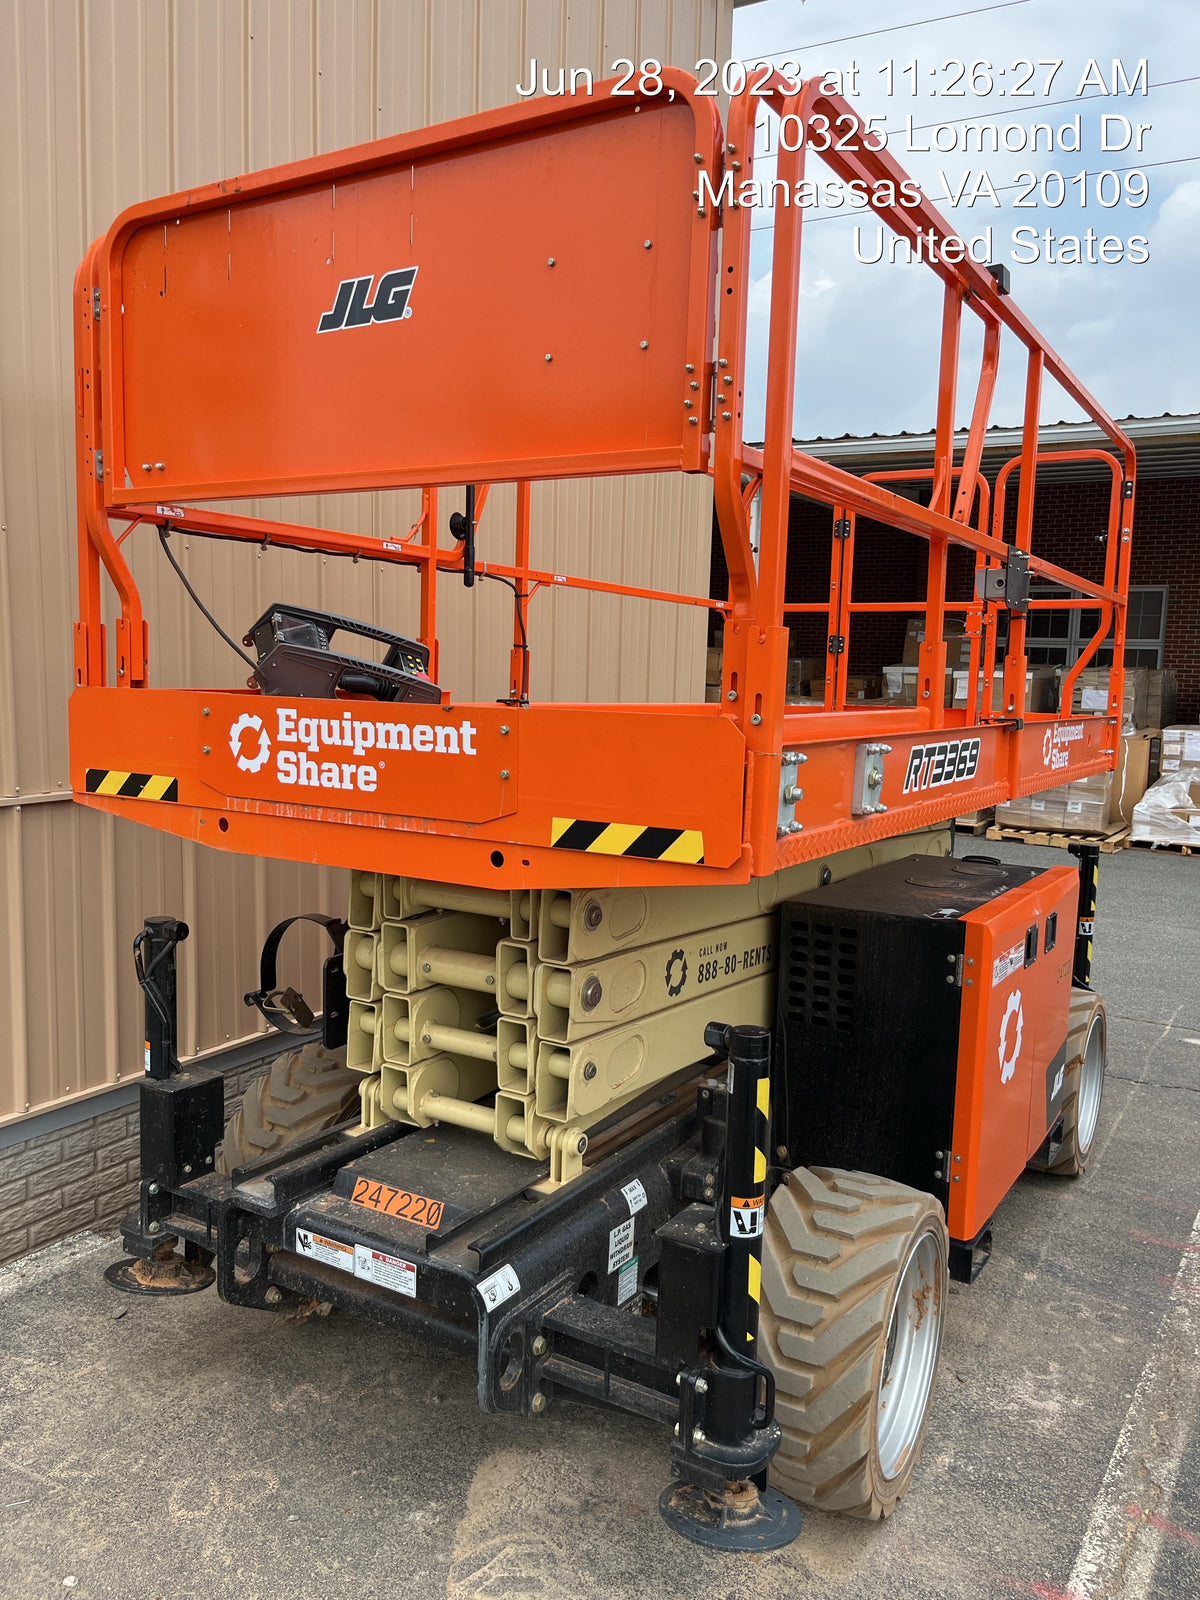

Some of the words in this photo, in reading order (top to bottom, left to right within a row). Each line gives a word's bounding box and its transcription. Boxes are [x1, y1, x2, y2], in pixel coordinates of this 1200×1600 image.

[317, 265, 419, 334] JLG
[276, 707, 477, 756] Equipment
[1053, 721, 1084, 748] Equipment
[276, 749, 378, 793] Share
[902, 737, 981, 795] RT3369
[1051, 748, 1069, 770] Share
[699, 945, 713, 958] CALL
[715, 941, 728, 953] NOW
[697, 943, 772, 984] 888-80-RENTS
[353, 1180, 442, 1227] 247220
[614, 1233, 630, 1248] LIQUID
[622, 1221, 632, 1233] GAS
[385, 1257, 407, 1270] DANGER
[612, 1252, 630, 1269] SYSTEM
